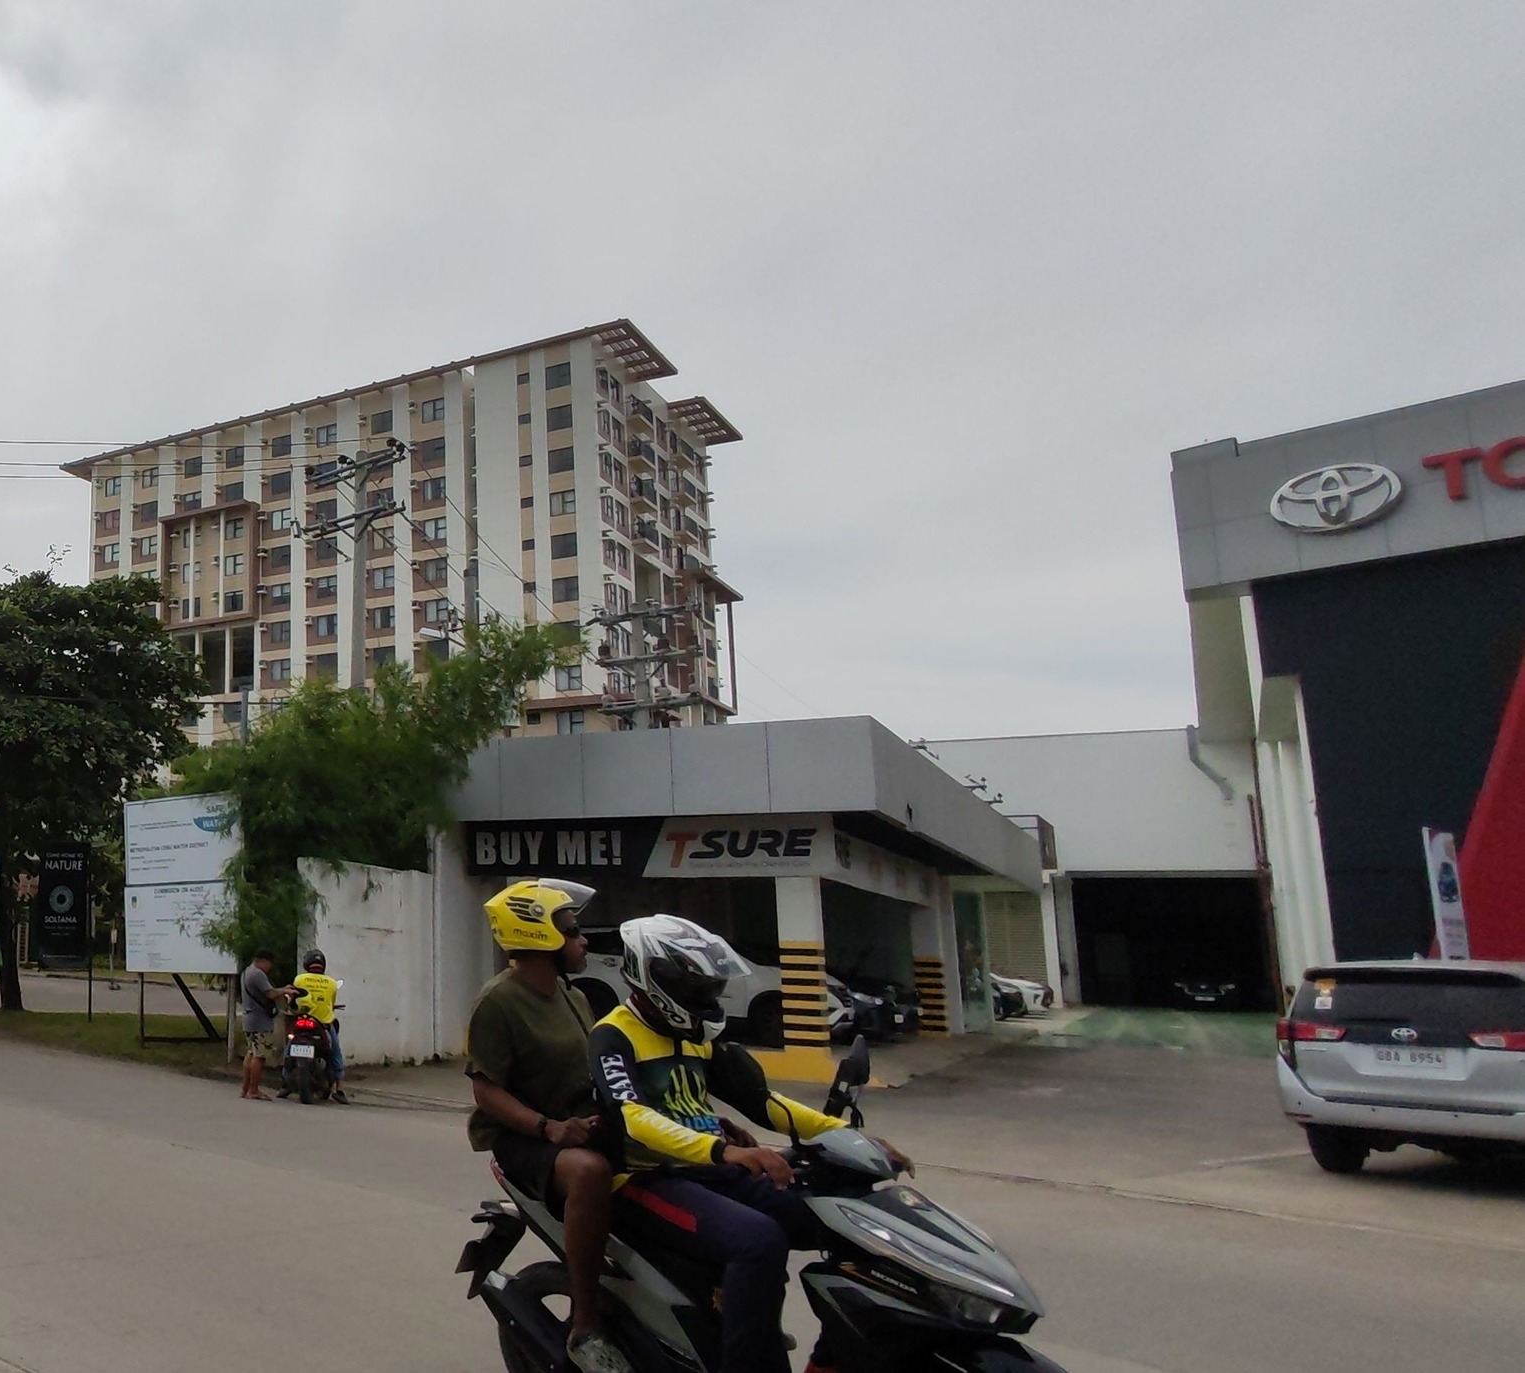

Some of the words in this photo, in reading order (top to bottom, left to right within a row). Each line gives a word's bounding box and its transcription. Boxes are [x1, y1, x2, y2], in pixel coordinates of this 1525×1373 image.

[476, 831, 544, 865] BUY
[556, 831, 622, 865] ME!
[45, 860, 83, 871] NATURE
[44, 915, 77, 924] SOLTANA
[513, 927, 548, 941] maxim
[600, 1054, 638, 1101] SAFE
[870, 1269, 919, 1295] HONDA
